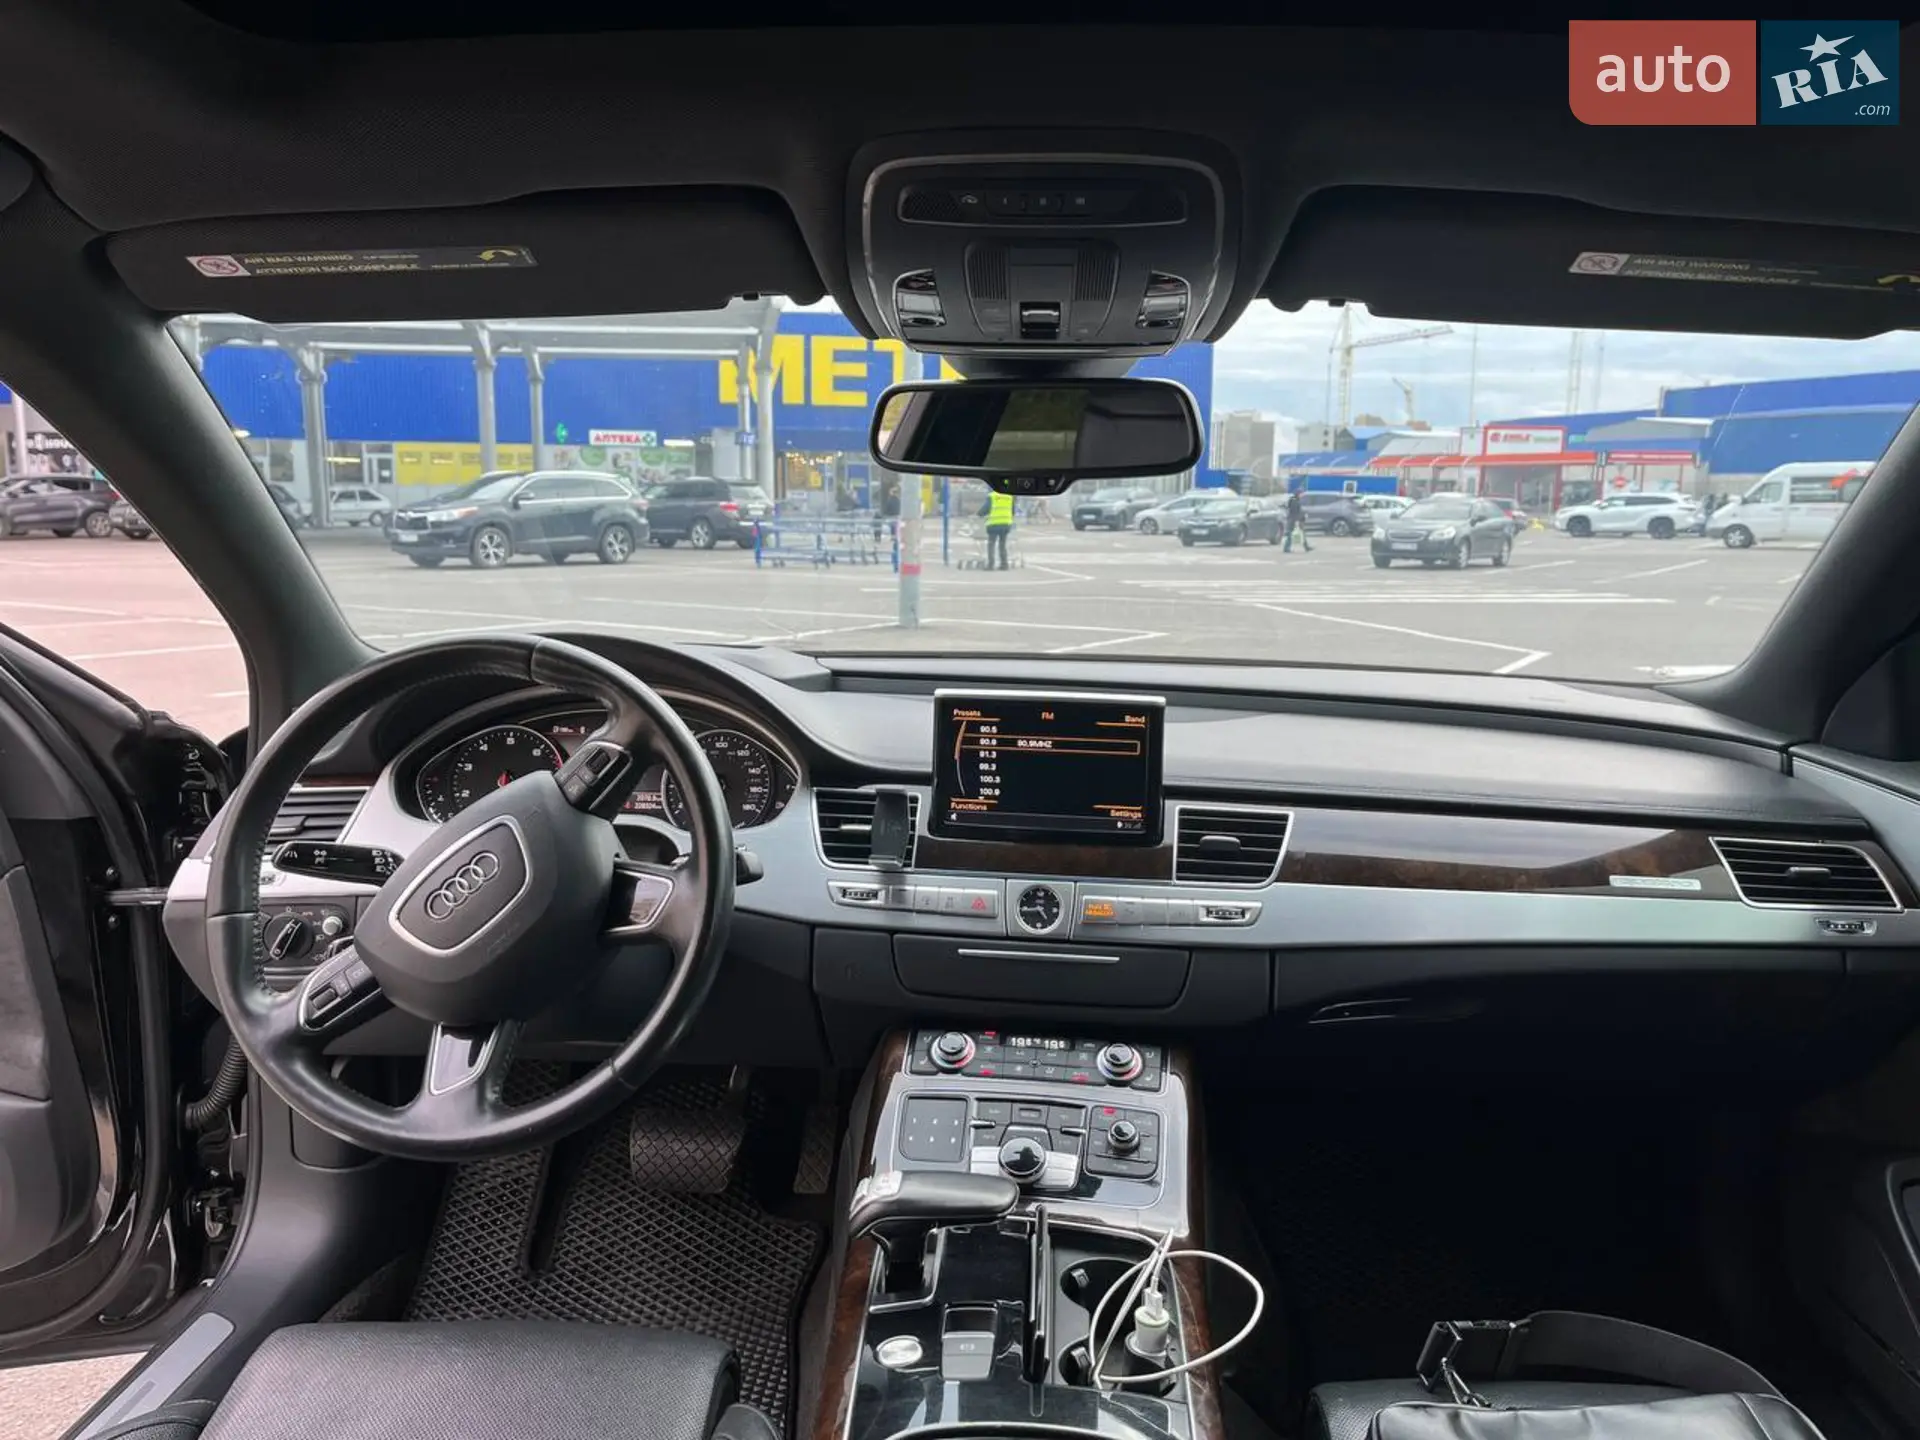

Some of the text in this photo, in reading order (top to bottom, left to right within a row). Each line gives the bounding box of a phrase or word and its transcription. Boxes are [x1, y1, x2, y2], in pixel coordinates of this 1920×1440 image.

[294, 253, 354, 263] WARNING
[719, 335, 957, 407] MET
[594, 433, 641, 444] АПТЕКА
[953, 708, 1146, 723] Presets FM Band
[950, 802, 1143, 819] Functions Settings
